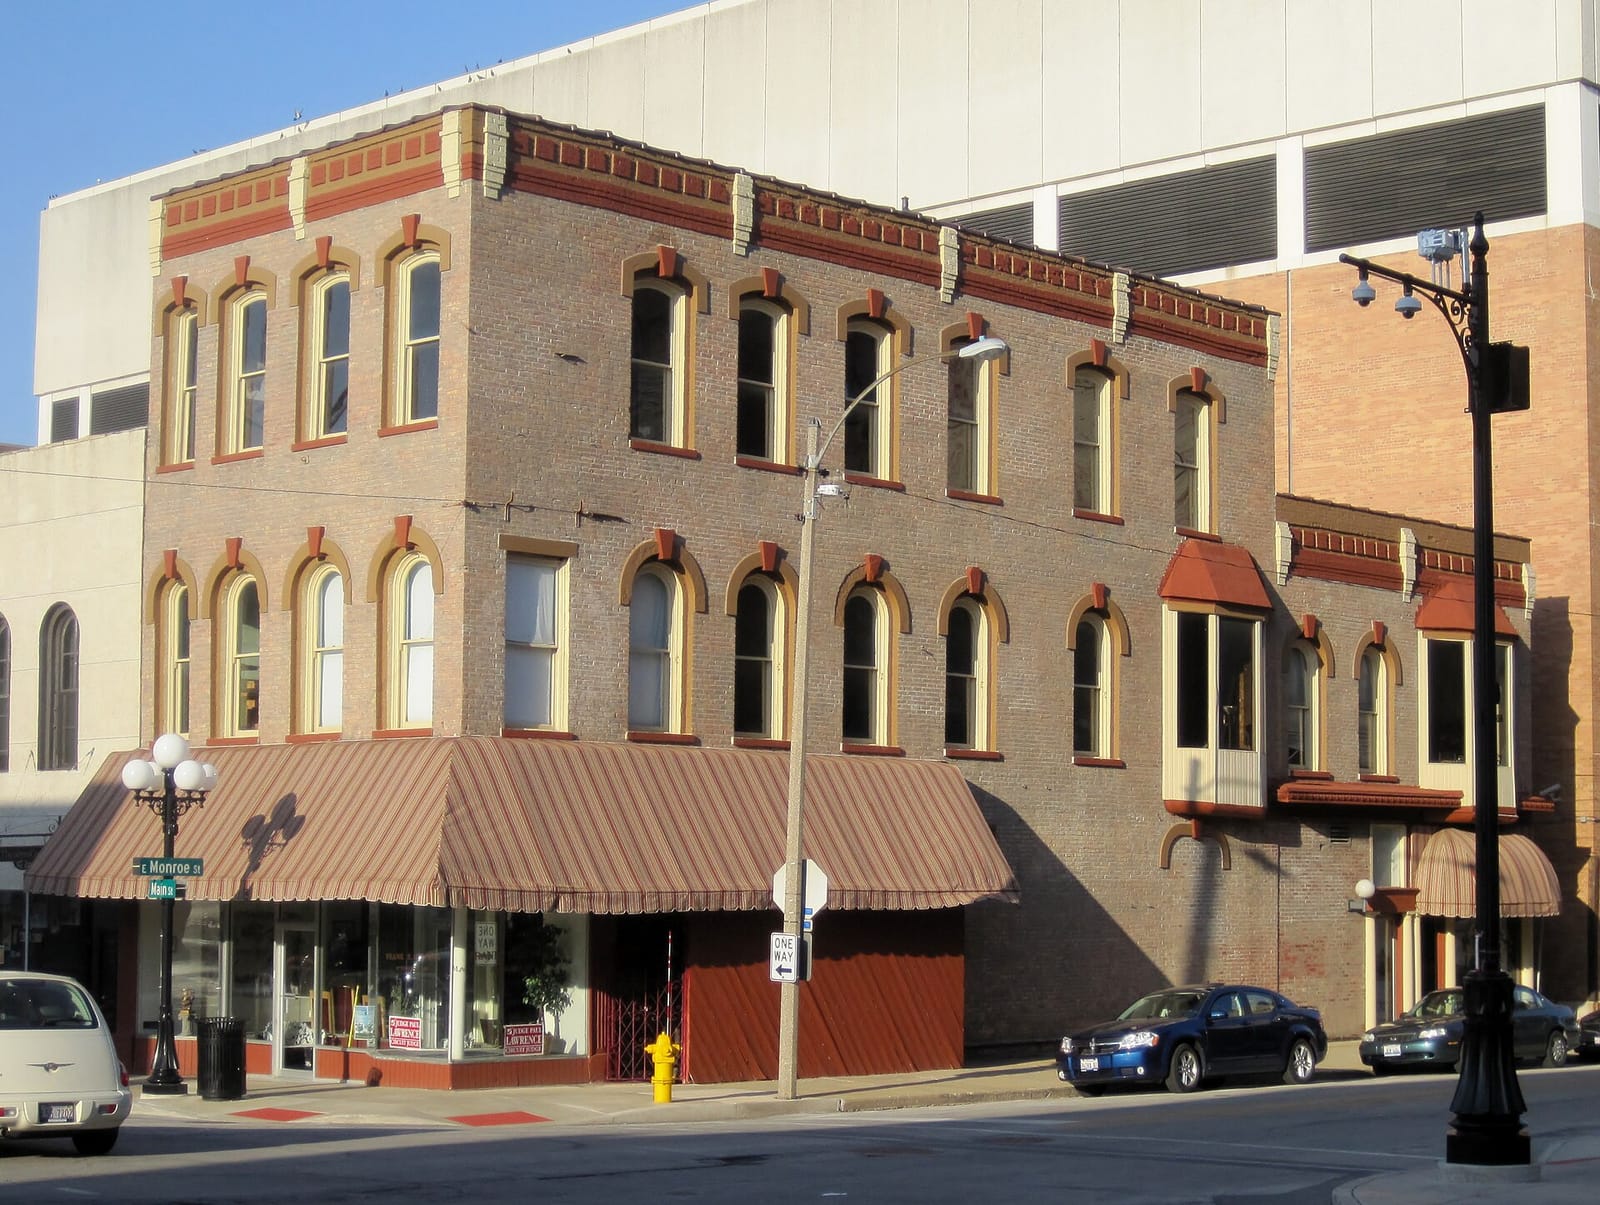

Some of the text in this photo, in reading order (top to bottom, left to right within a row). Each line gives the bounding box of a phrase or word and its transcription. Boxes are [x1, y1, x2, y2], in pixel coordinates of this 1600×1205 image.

[141, 860, 201, 874] E Monroe St
[151, 882, 167, 896] Main
[774, 937, 793, 949] ONE
[774, 951, 793, 963] WAY
[506, 1035, 542, 1045] LAWRENCE
